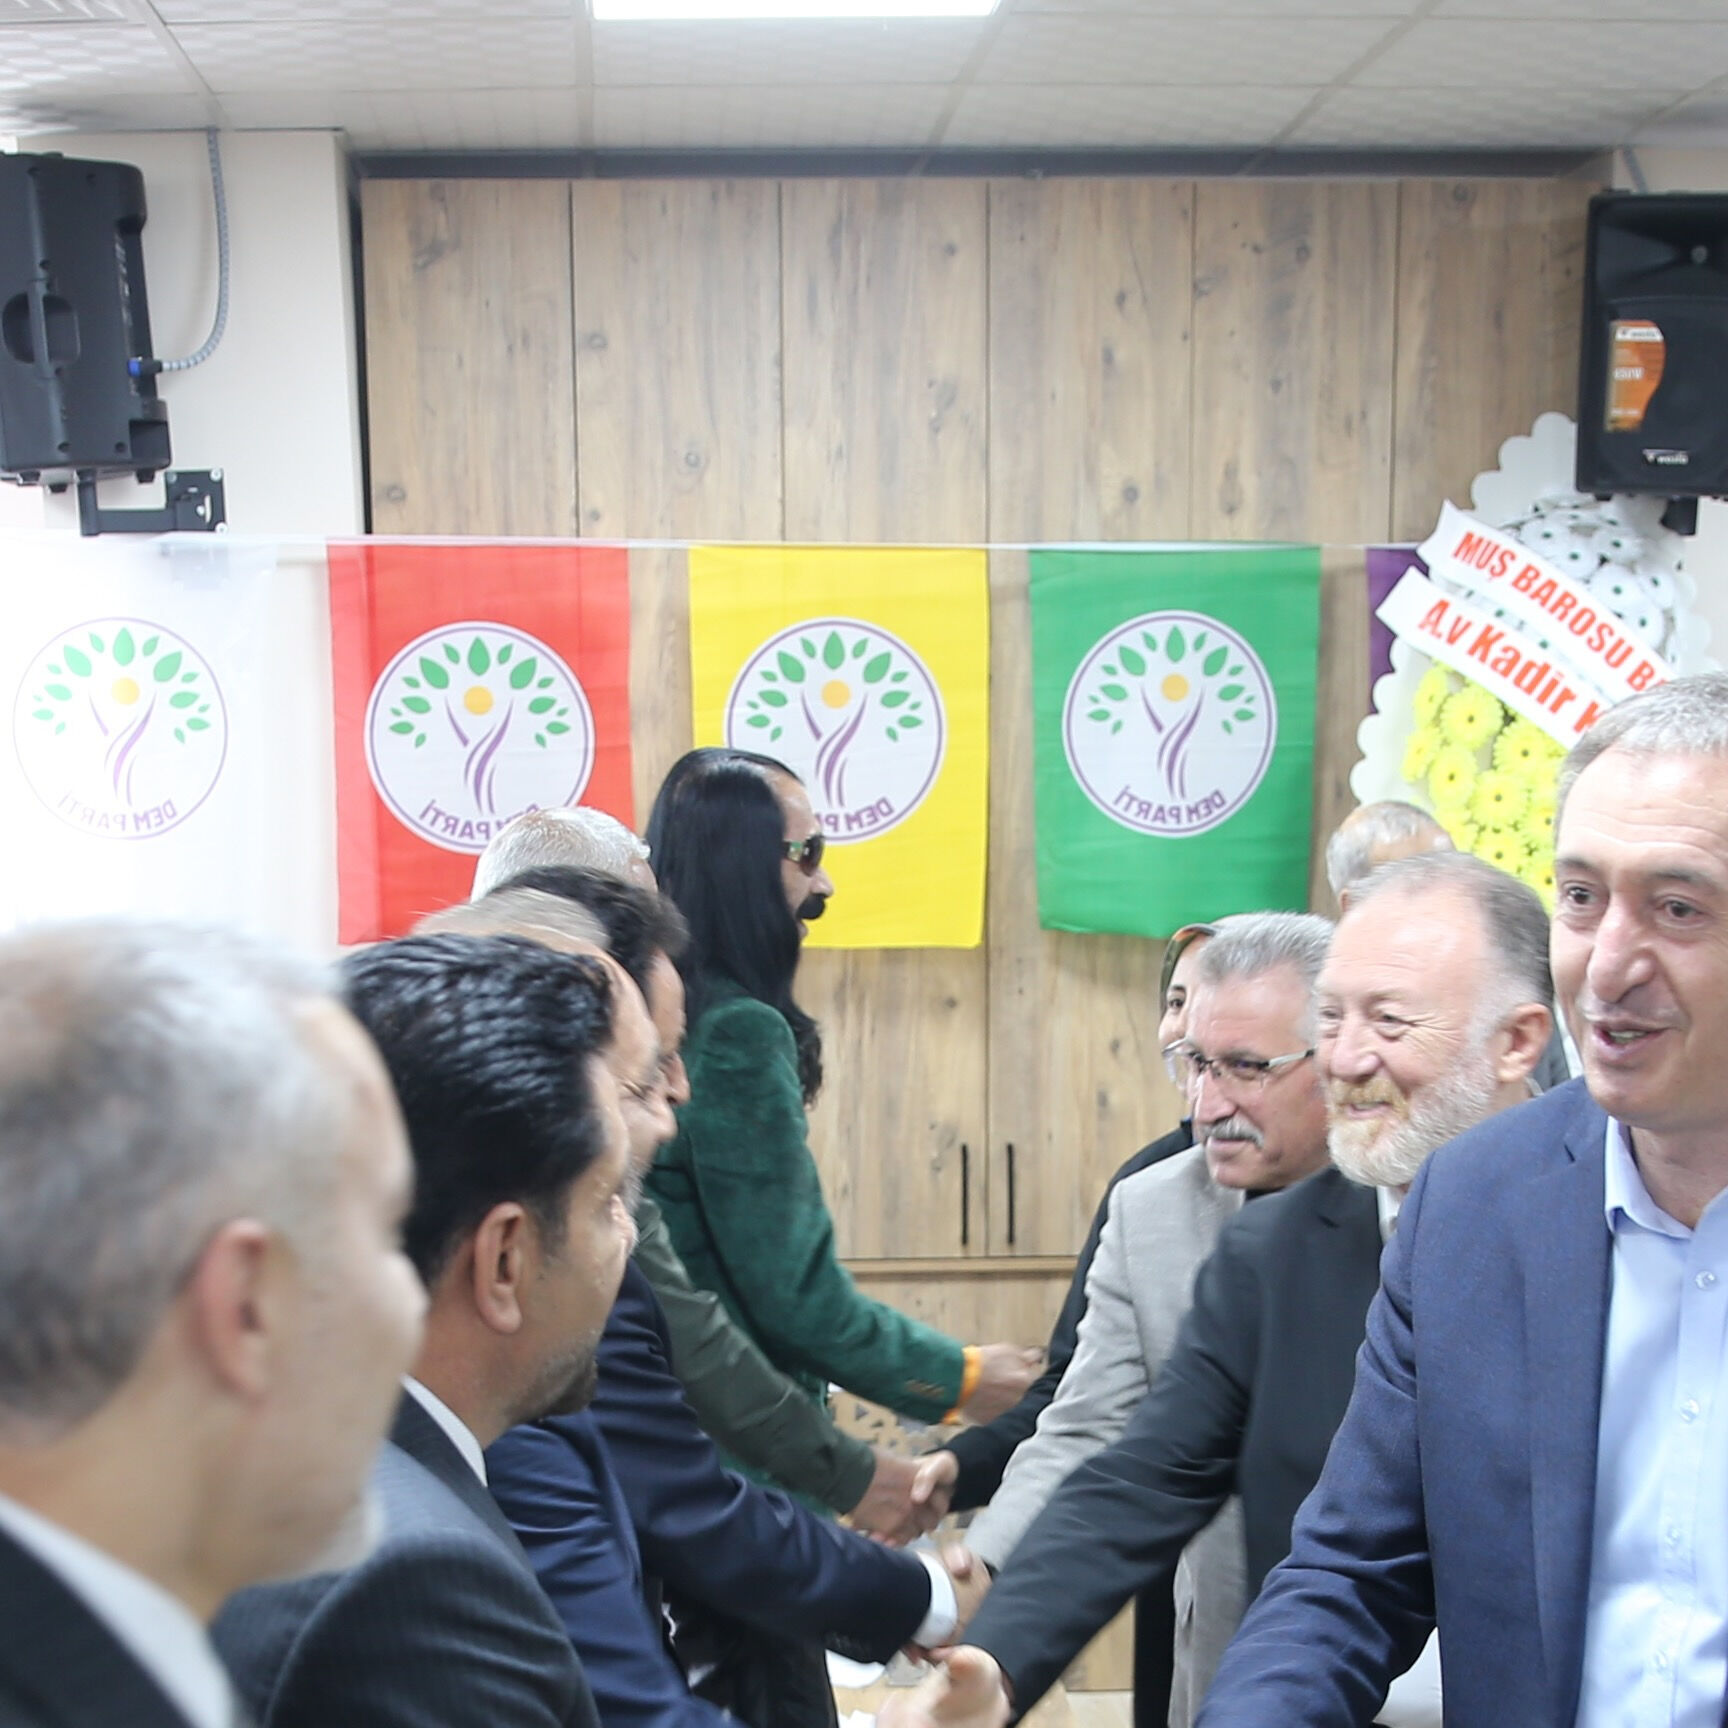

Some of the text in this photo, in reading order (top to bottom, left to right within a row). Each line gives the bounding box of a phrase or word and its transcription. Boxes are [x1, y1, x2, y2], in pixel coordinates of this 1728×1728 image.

[1452, 530, 1517, 582] MUŞ
[1511, 564, 1634, 669] BAROSU
[1466, 621, 1577, 716] Kadir
